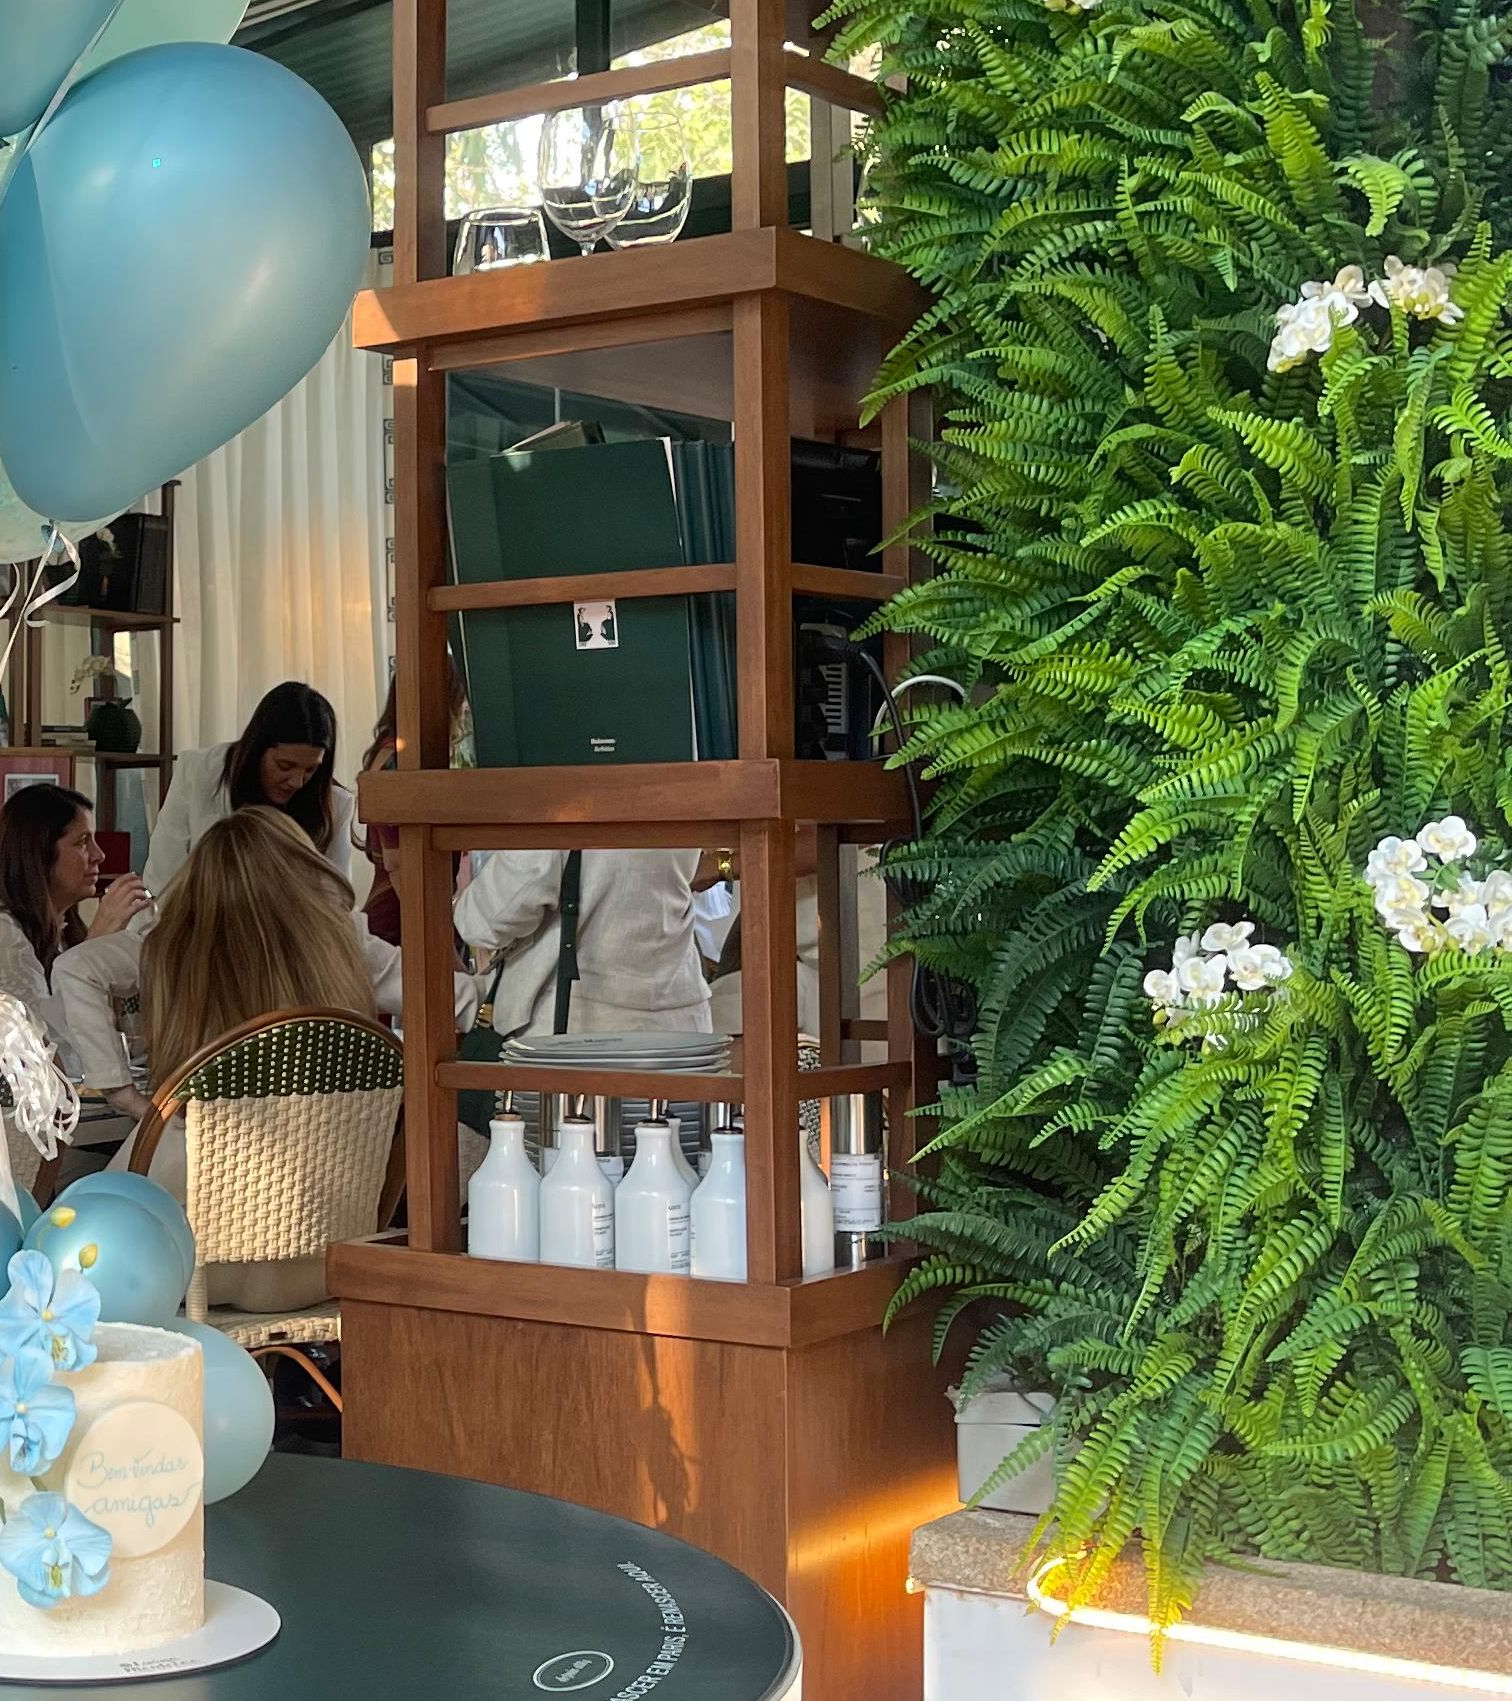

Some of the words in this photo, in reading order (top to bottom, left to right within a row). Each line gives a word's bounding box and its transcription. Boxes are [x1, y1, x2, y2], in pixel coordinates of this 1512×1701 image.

[85, 1483, 199, 1528] amigas
[641, 1582, 686, 1625] RENASCER
[646, 1660, 676, 1676] EM
